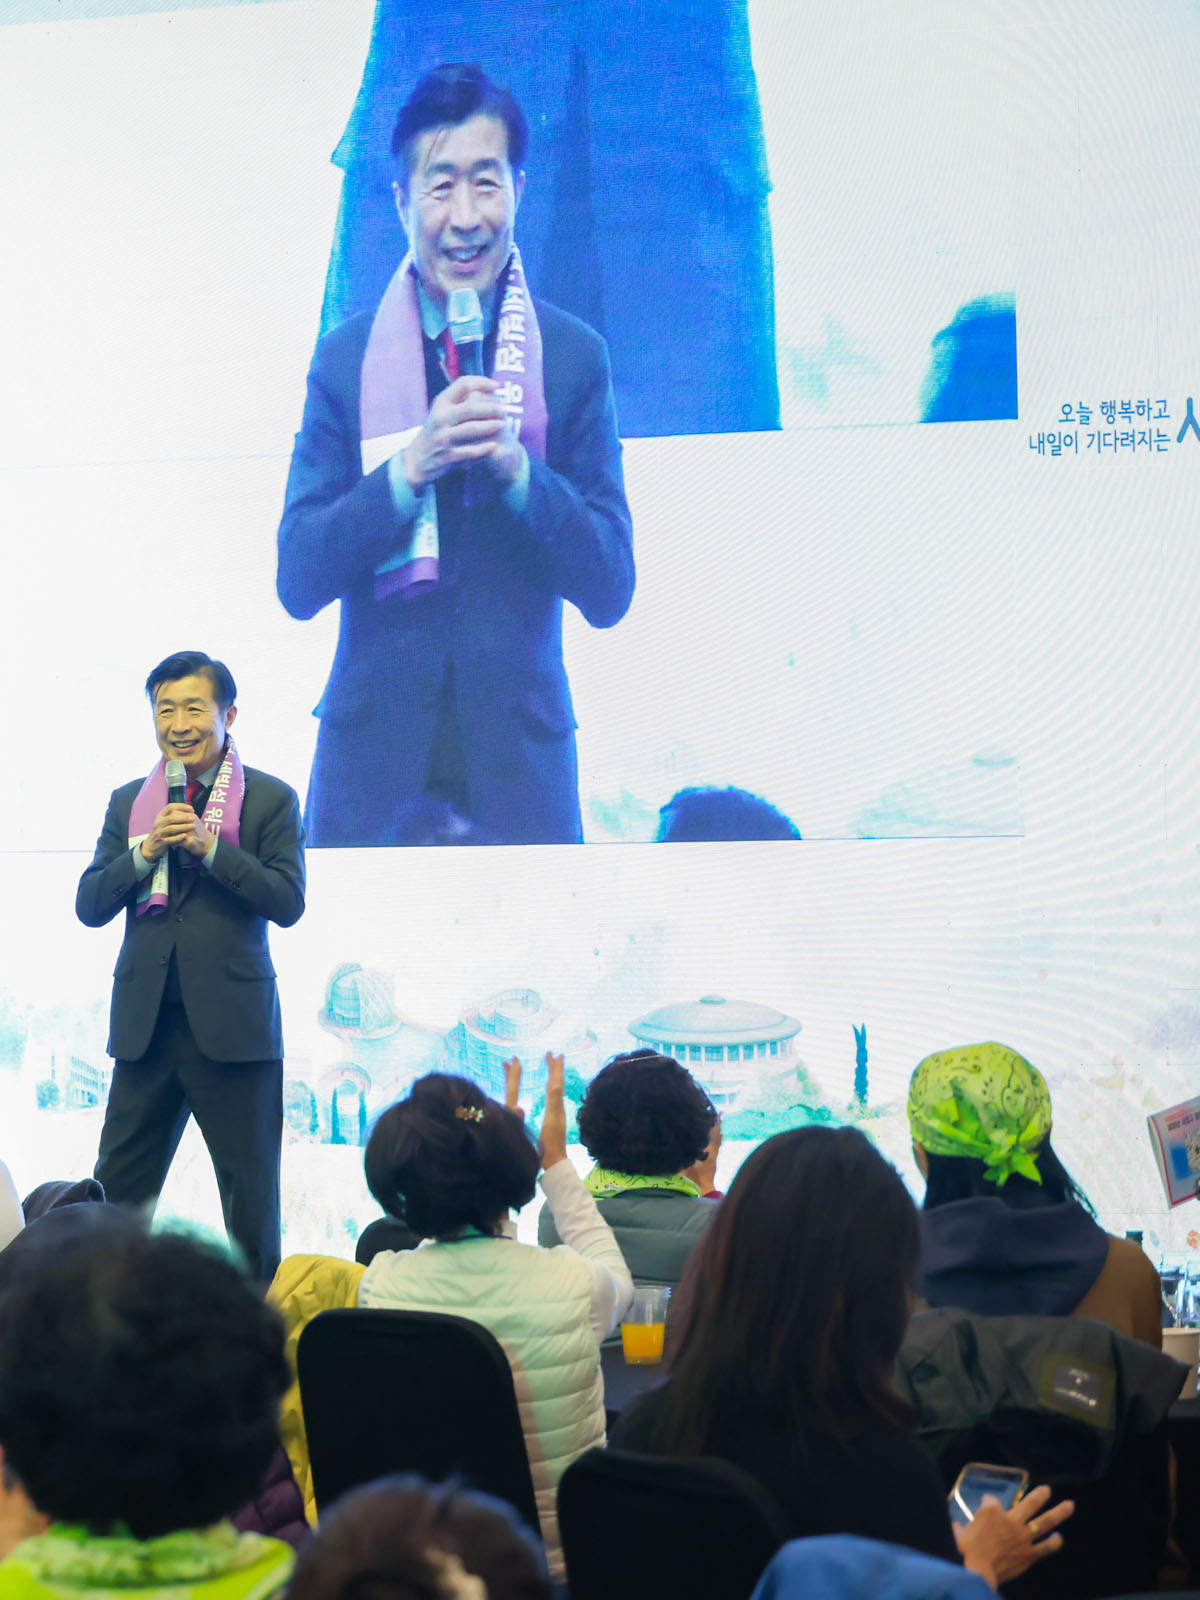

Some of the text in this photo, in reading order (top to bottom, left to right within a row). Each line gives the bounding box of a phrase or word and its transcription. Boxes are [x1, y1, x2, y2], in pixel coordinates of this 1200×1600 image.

[1058, 401, 1093, 426] 오늘
[1100, 398, 1170, 425] 행복하고
[1029, 428, 1171, 456] 내일이 기다려지는
